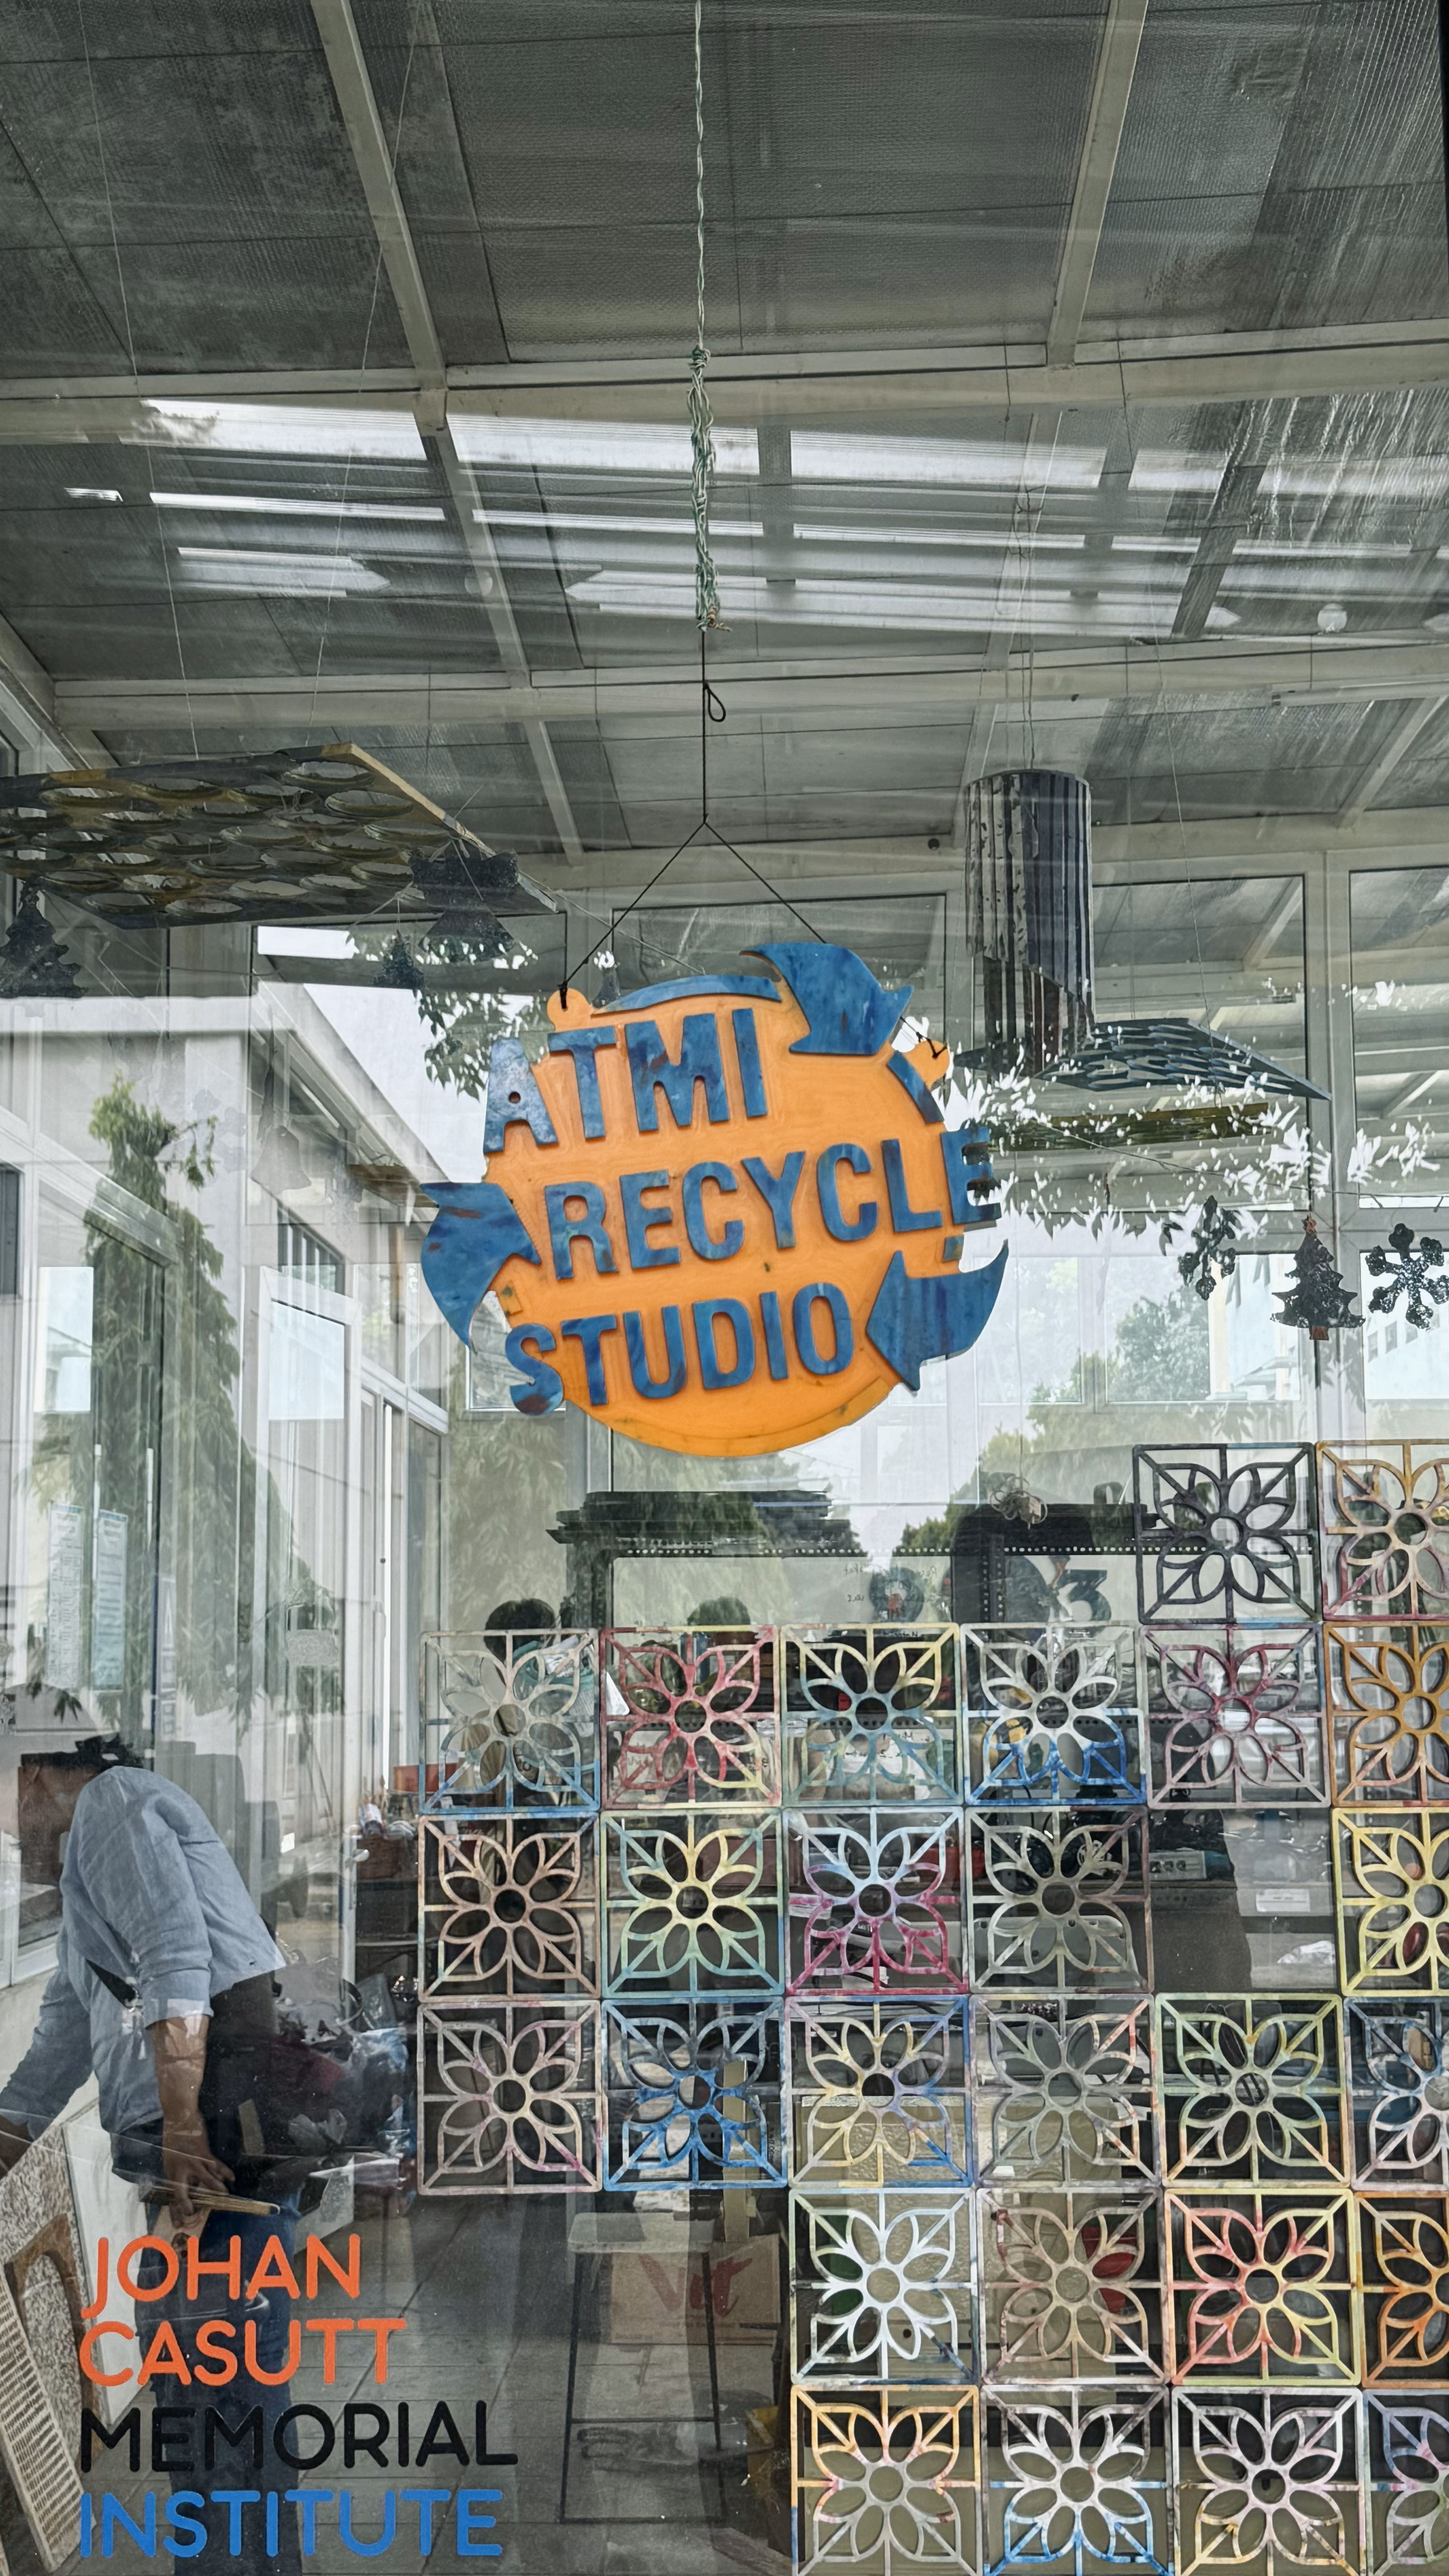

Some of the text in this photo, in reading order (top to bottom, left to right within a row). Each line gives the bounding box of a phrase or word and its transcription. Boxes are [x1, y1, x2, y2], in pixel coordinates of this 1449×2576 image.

[483, 1007, 768, 1154] ATMI
[543, 1126, 1003, 1280] RECYCLE
[505, 1282, 855, 1416] STUDIO
[80, 2233, 361, 2320] JOHAN
[79, 2318, 406, 2387] CASUTT
[80, 2400, 519, 2473] MEMORIAL
[79, 2488, 504, 2558] INSTITUTE
